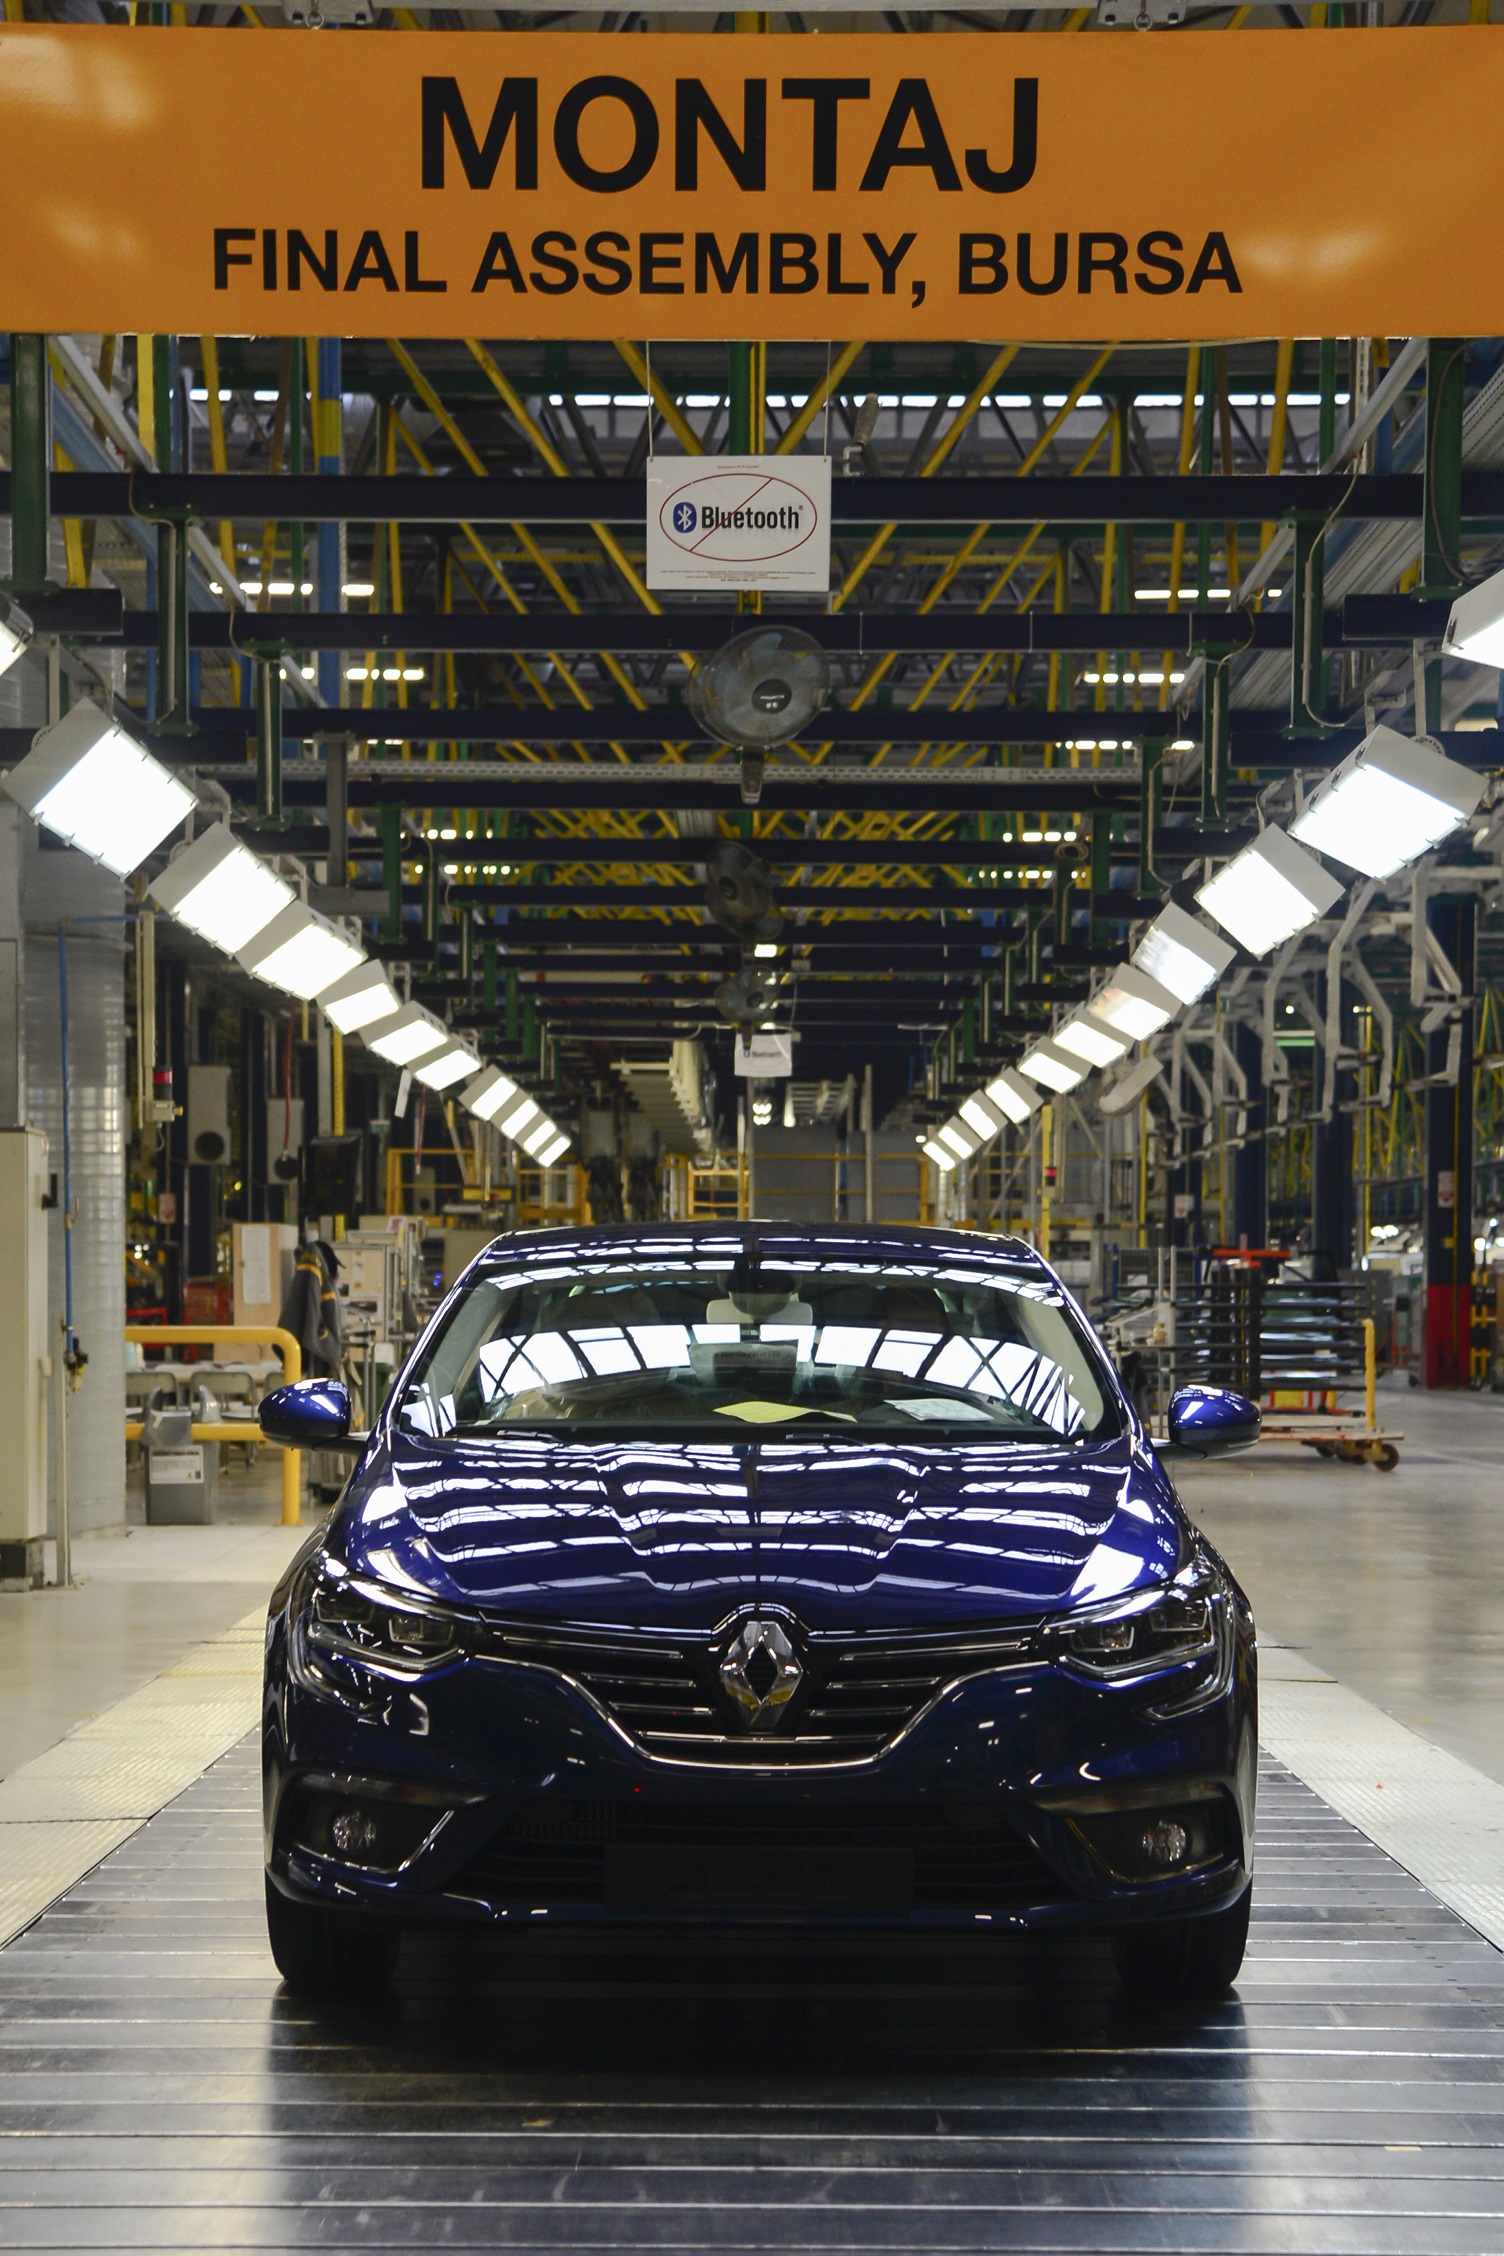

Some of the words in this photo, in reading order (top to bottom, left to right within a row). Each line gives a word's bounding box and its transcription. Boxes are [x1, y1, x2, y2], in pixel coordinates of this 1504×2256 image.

[421, 75, 1039, 195] MONTAJ
[213, 227, 448, 293] FINAL
[470, 230, 926, 309] ASSEMBLY,
[958, 230, 1244, 296] BURSA
